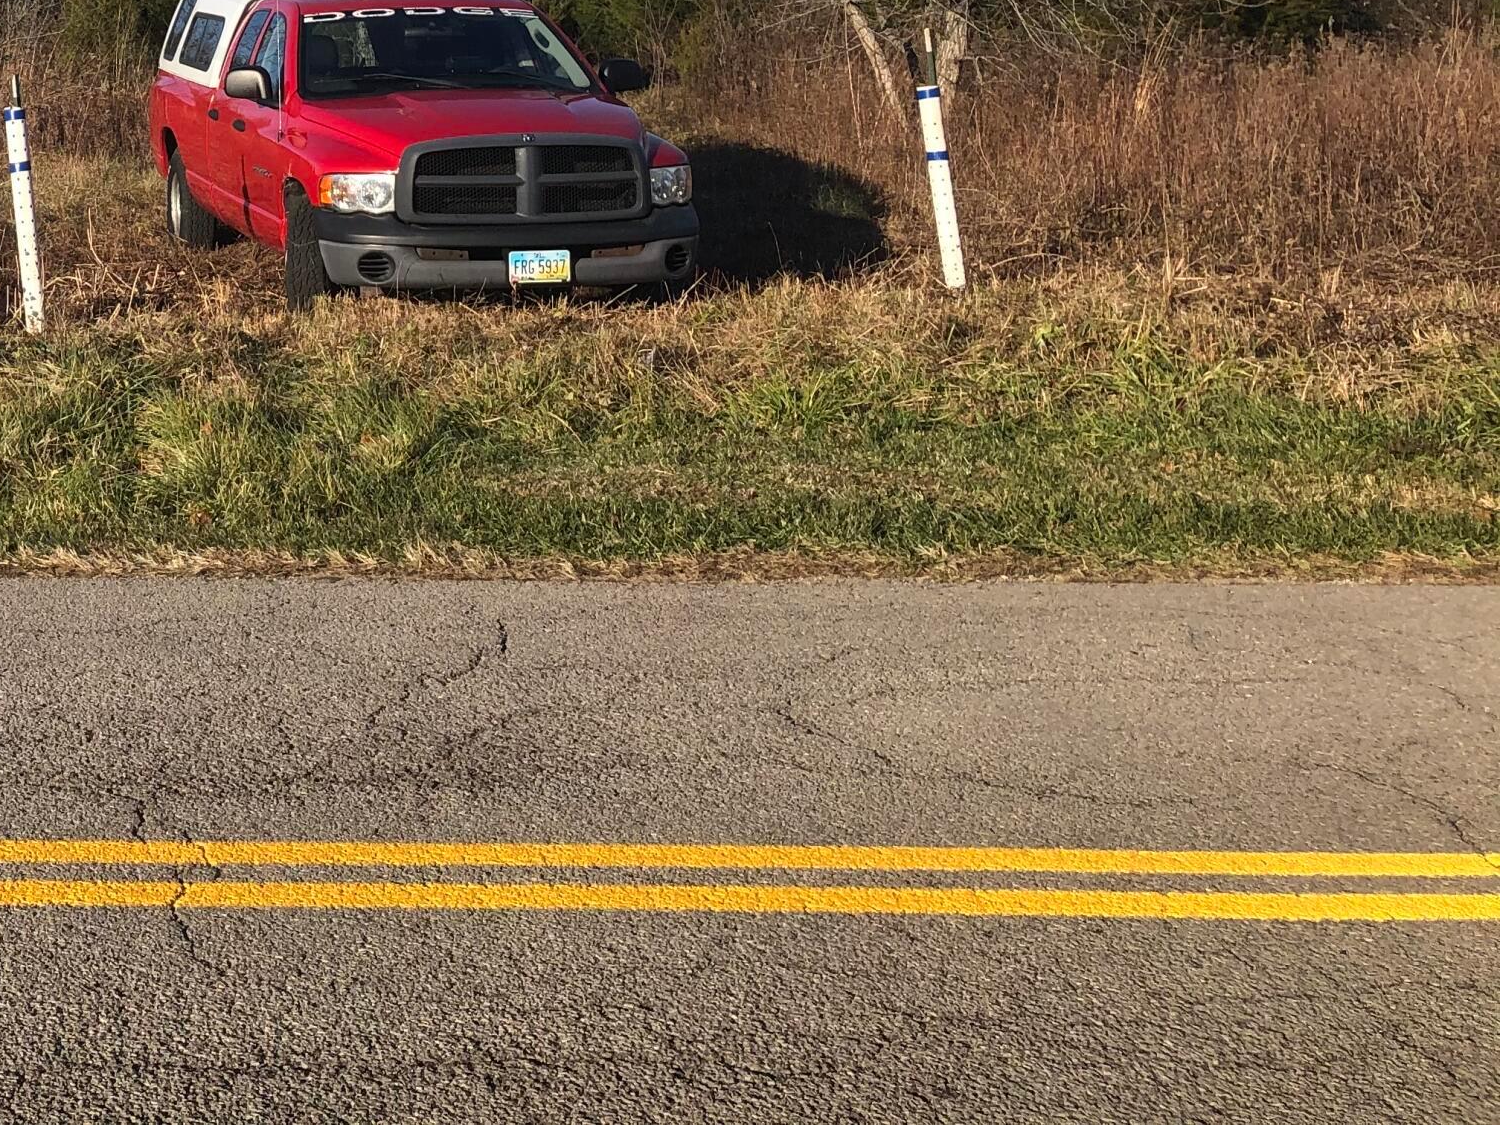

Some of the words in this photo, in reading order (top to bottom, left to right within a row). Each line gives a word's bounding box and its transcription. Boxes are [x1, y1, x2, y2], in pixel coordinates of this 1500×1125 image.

[303, 7, 539, 23] DODGE
[514, 259, 535, 275] FRG
[538, 259, 566, 274] 5937
